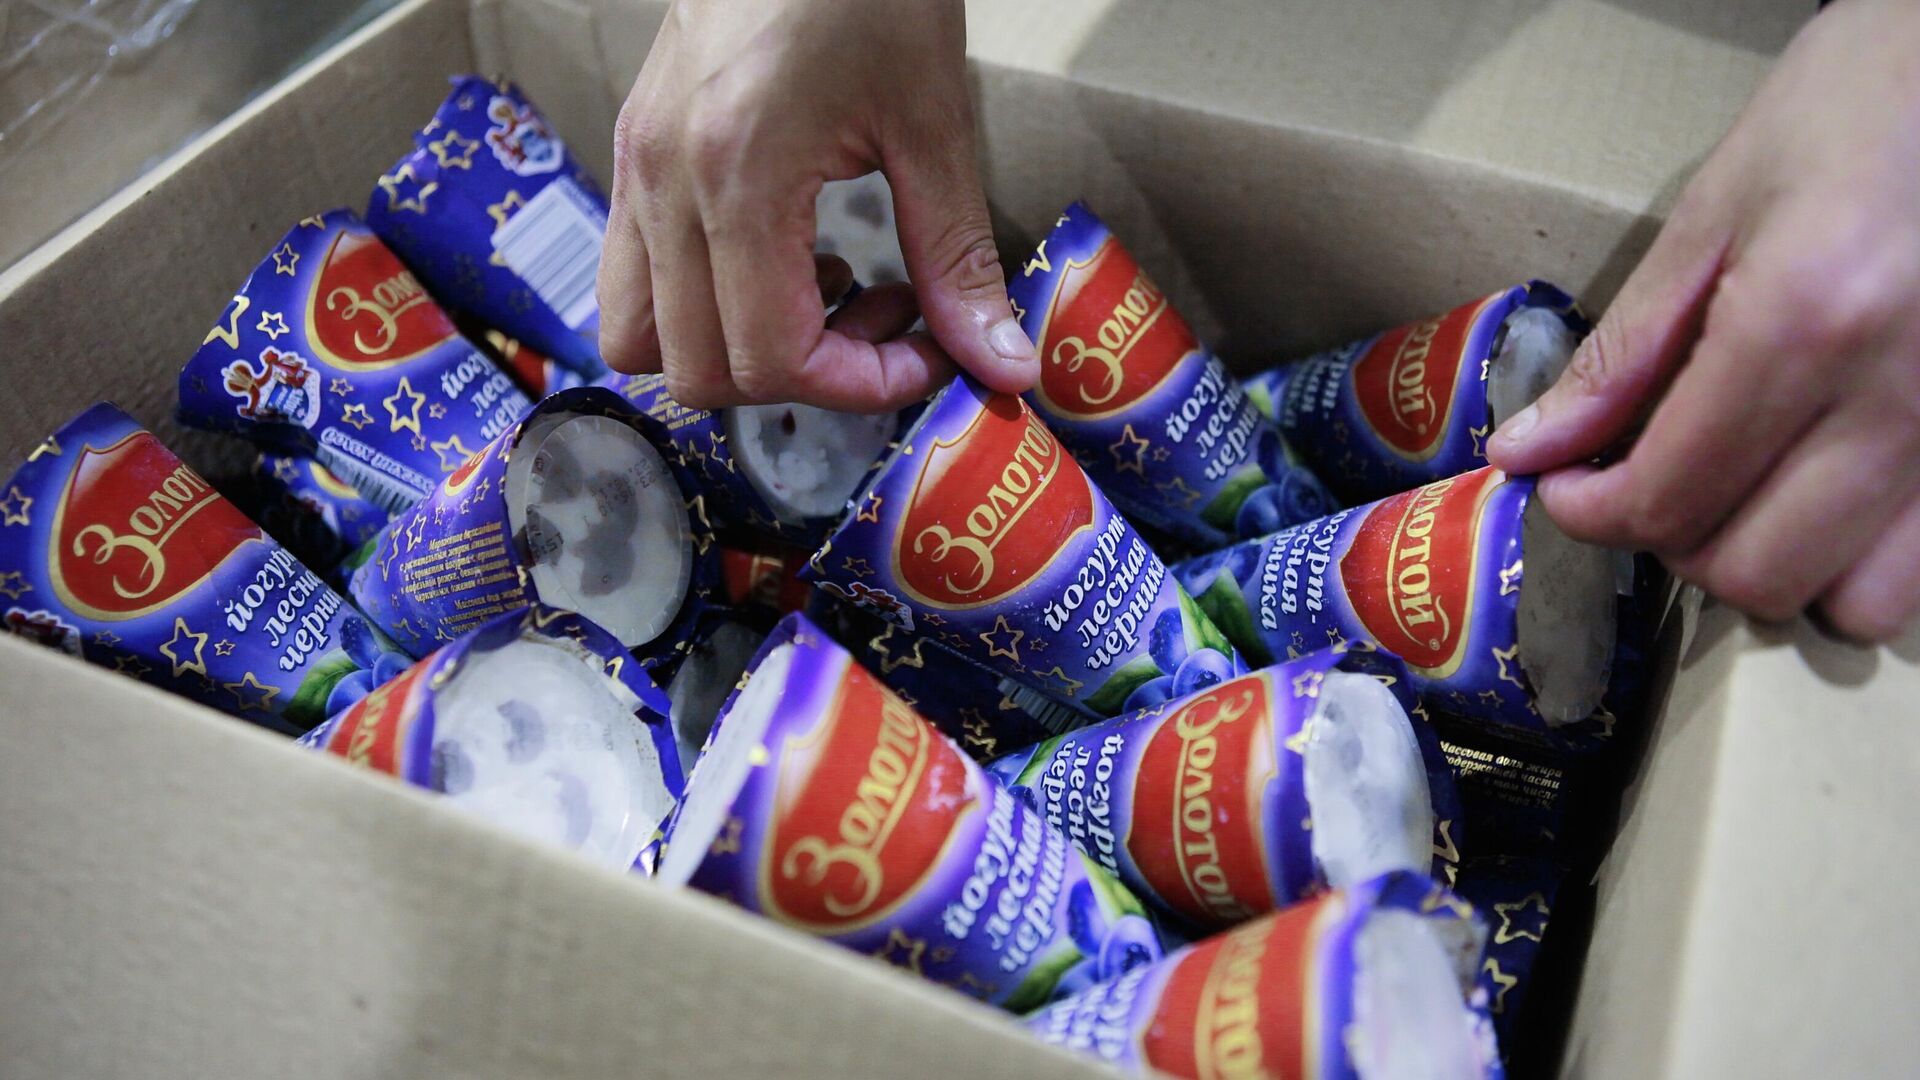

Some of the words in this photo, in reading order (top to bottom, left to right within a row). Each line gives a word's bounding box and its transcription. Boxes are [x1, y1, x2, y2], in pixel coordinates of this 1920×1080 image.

[1052, 268, 1168, 404] Золот
[1166, 357, 1225, 443] йогур
[73, 463, 221, 599] Золот
[1261, 528, 1298, 630] рника
[1281, 518, 1324, 614] есная
[1306, 508, 1350, 624] огурт-
[1387, 479, 1455, 645] олотой
[224, 547, 295, 632] йогур
[263, 570, 322, 647] лесна
[279, 588, 342, 670] черни
[1077, 537, 1147, 648] лесная
[1087, 553, 1167, 670] черника
[781, 697, 930, 917] Золото
[1042, 740, 1075, 826] черн
[1068, 746, 1092, 857] лесн
